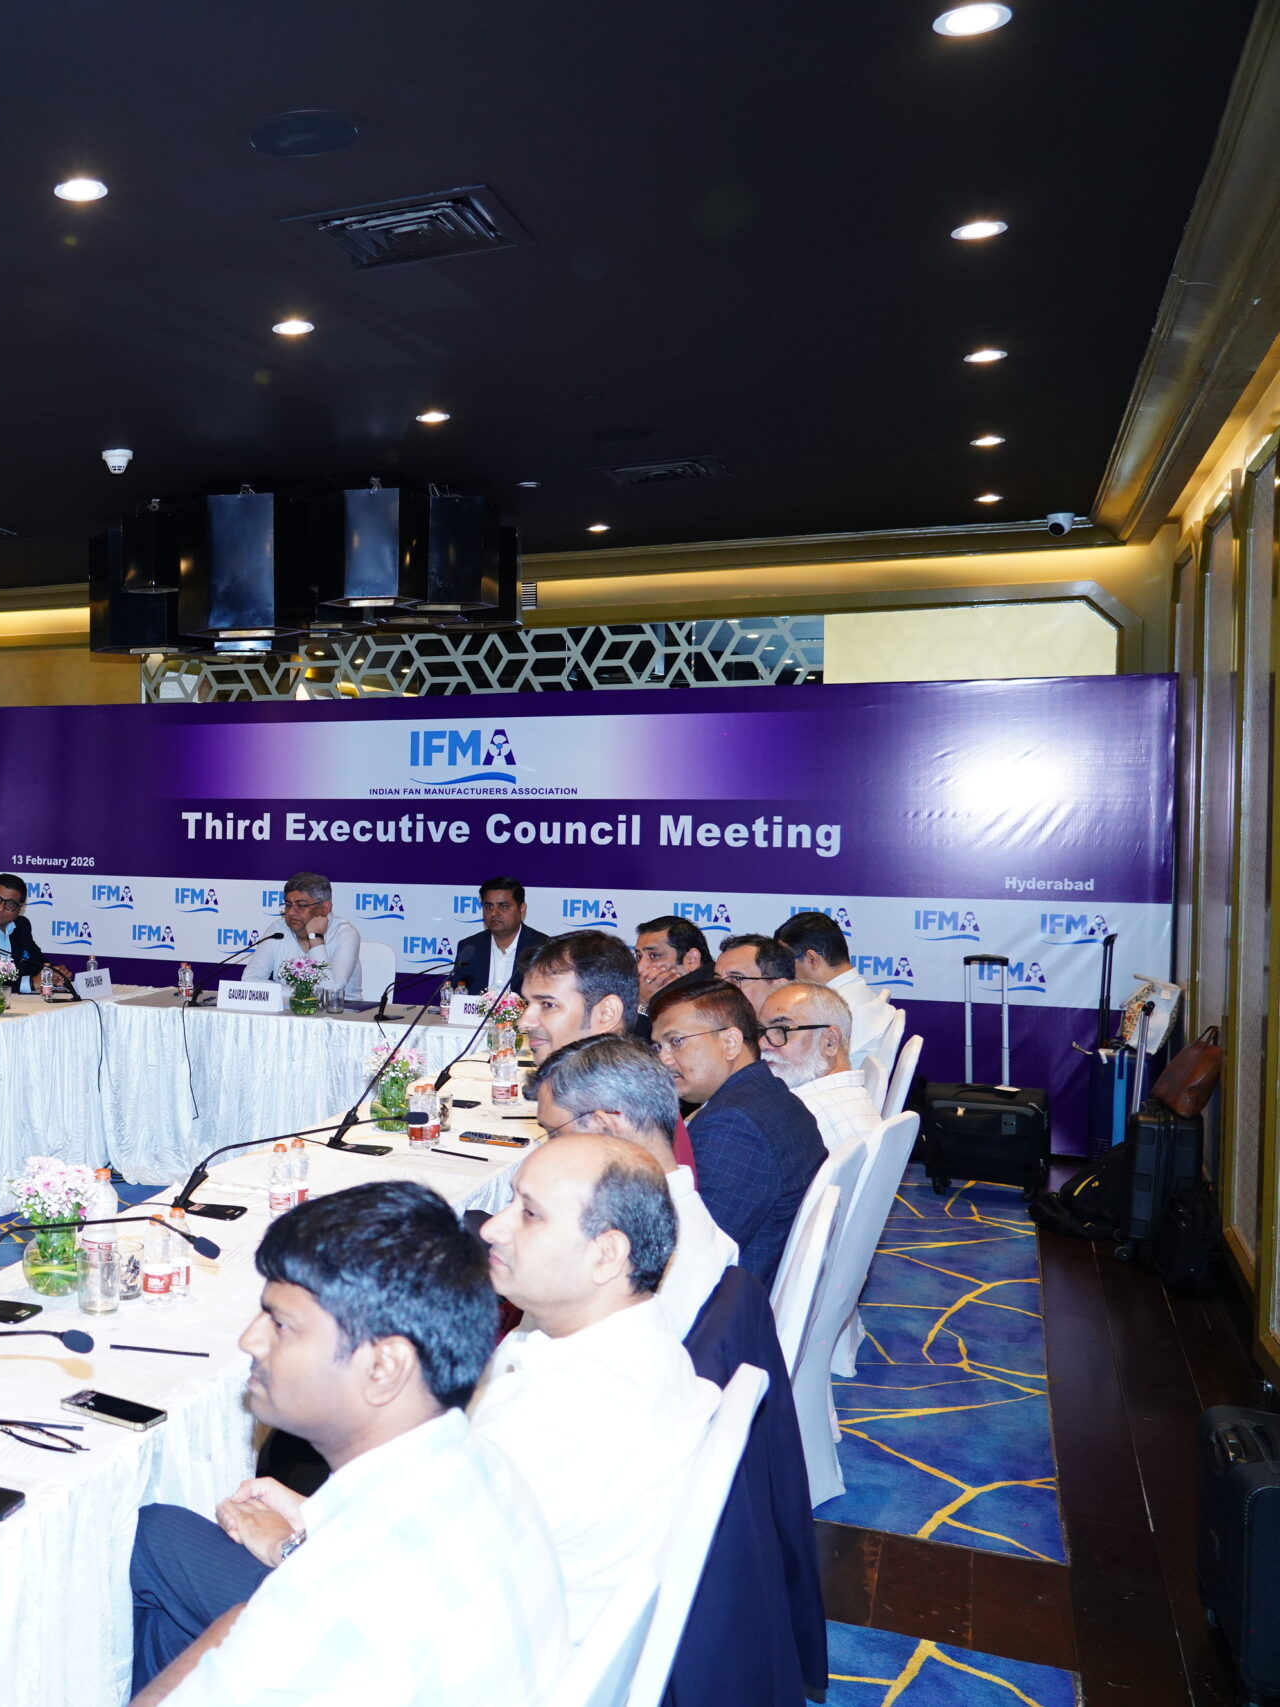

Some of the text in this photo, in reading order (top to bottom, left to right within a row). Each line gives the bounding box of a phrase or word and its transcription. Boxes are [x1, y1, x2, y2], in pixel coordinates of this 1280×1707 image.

[410, 729, 517, 767] IFMA
[424, 787, 508, 795] MANUFACTURERS
[511, 787, 578, 795] ASSOCIATION
[181, 812, 841, 858] Third Executive Council Meeting
[11, 854, 95, 869] 13 February 2026
[1005, 876, 1095, 893] Hyderabad
[92, 885, 133, 902] IFMA
[175, 888, 219, 905] IFMA
[355, 893, 404, 911] IFMA
[562, 899, 617, 919] IFMA
[673, 903, 731, 923] IFMA
[914, 910, 980, 931] IFMA
[1041, 913, 1109, 935] IFMA
[51, 921, 92, 938] IFMA
[132, 925, 175, 942] IFMA
[403, 936, 453, 955] IFMA
[228, 988, 270, 1002] GAURAV DHAWAN
